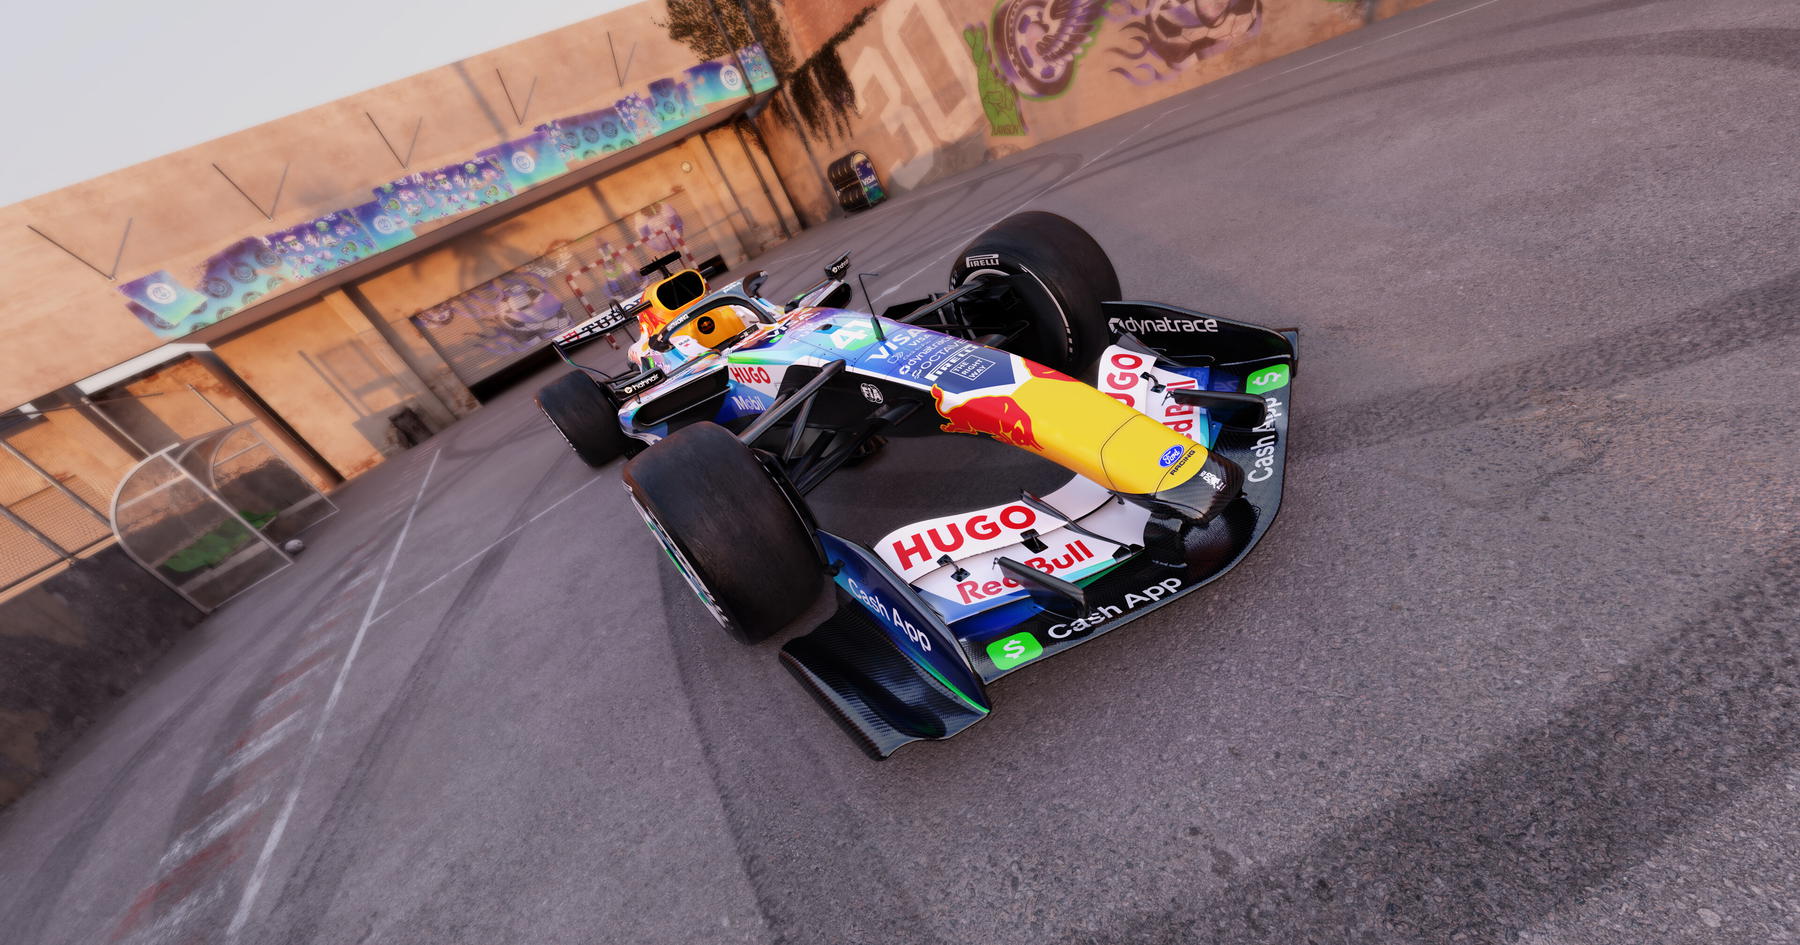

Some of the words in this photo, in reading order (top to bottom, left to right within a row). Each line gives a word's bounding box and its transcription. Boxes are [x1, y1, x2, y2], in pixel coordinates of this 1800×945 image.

[966, 254, 999, 268] PIRELLI
[1125, 316, 1218, 335] dynatrace
[865, 328, 929, 362] VISA
[729, 366, 771, 385] HUGO
[954, 361, 969, 373] THE
[961, 359, 983, 376] RIGHT
[969, 365, 987, 379] WAY
[633, 372, 660, 392] hahnair
[731, 396, 767, 411] Mobil
[1252, 397, 1283, 433] App
[1162, 447, 1183, 466] Ford
[1169, 450, 1197, 477] RACING
[1247, 434, 1276, 483] Cash
[892, 505, 1036, 571] HUGO
[1024, 539, 1094, 576] Bull
[848, 577, 891, 621] Cash
[892, 607, 931, 652] App
[1048, 604, 1123, 640] Cash
[1124, 577, 1182, 609] App
